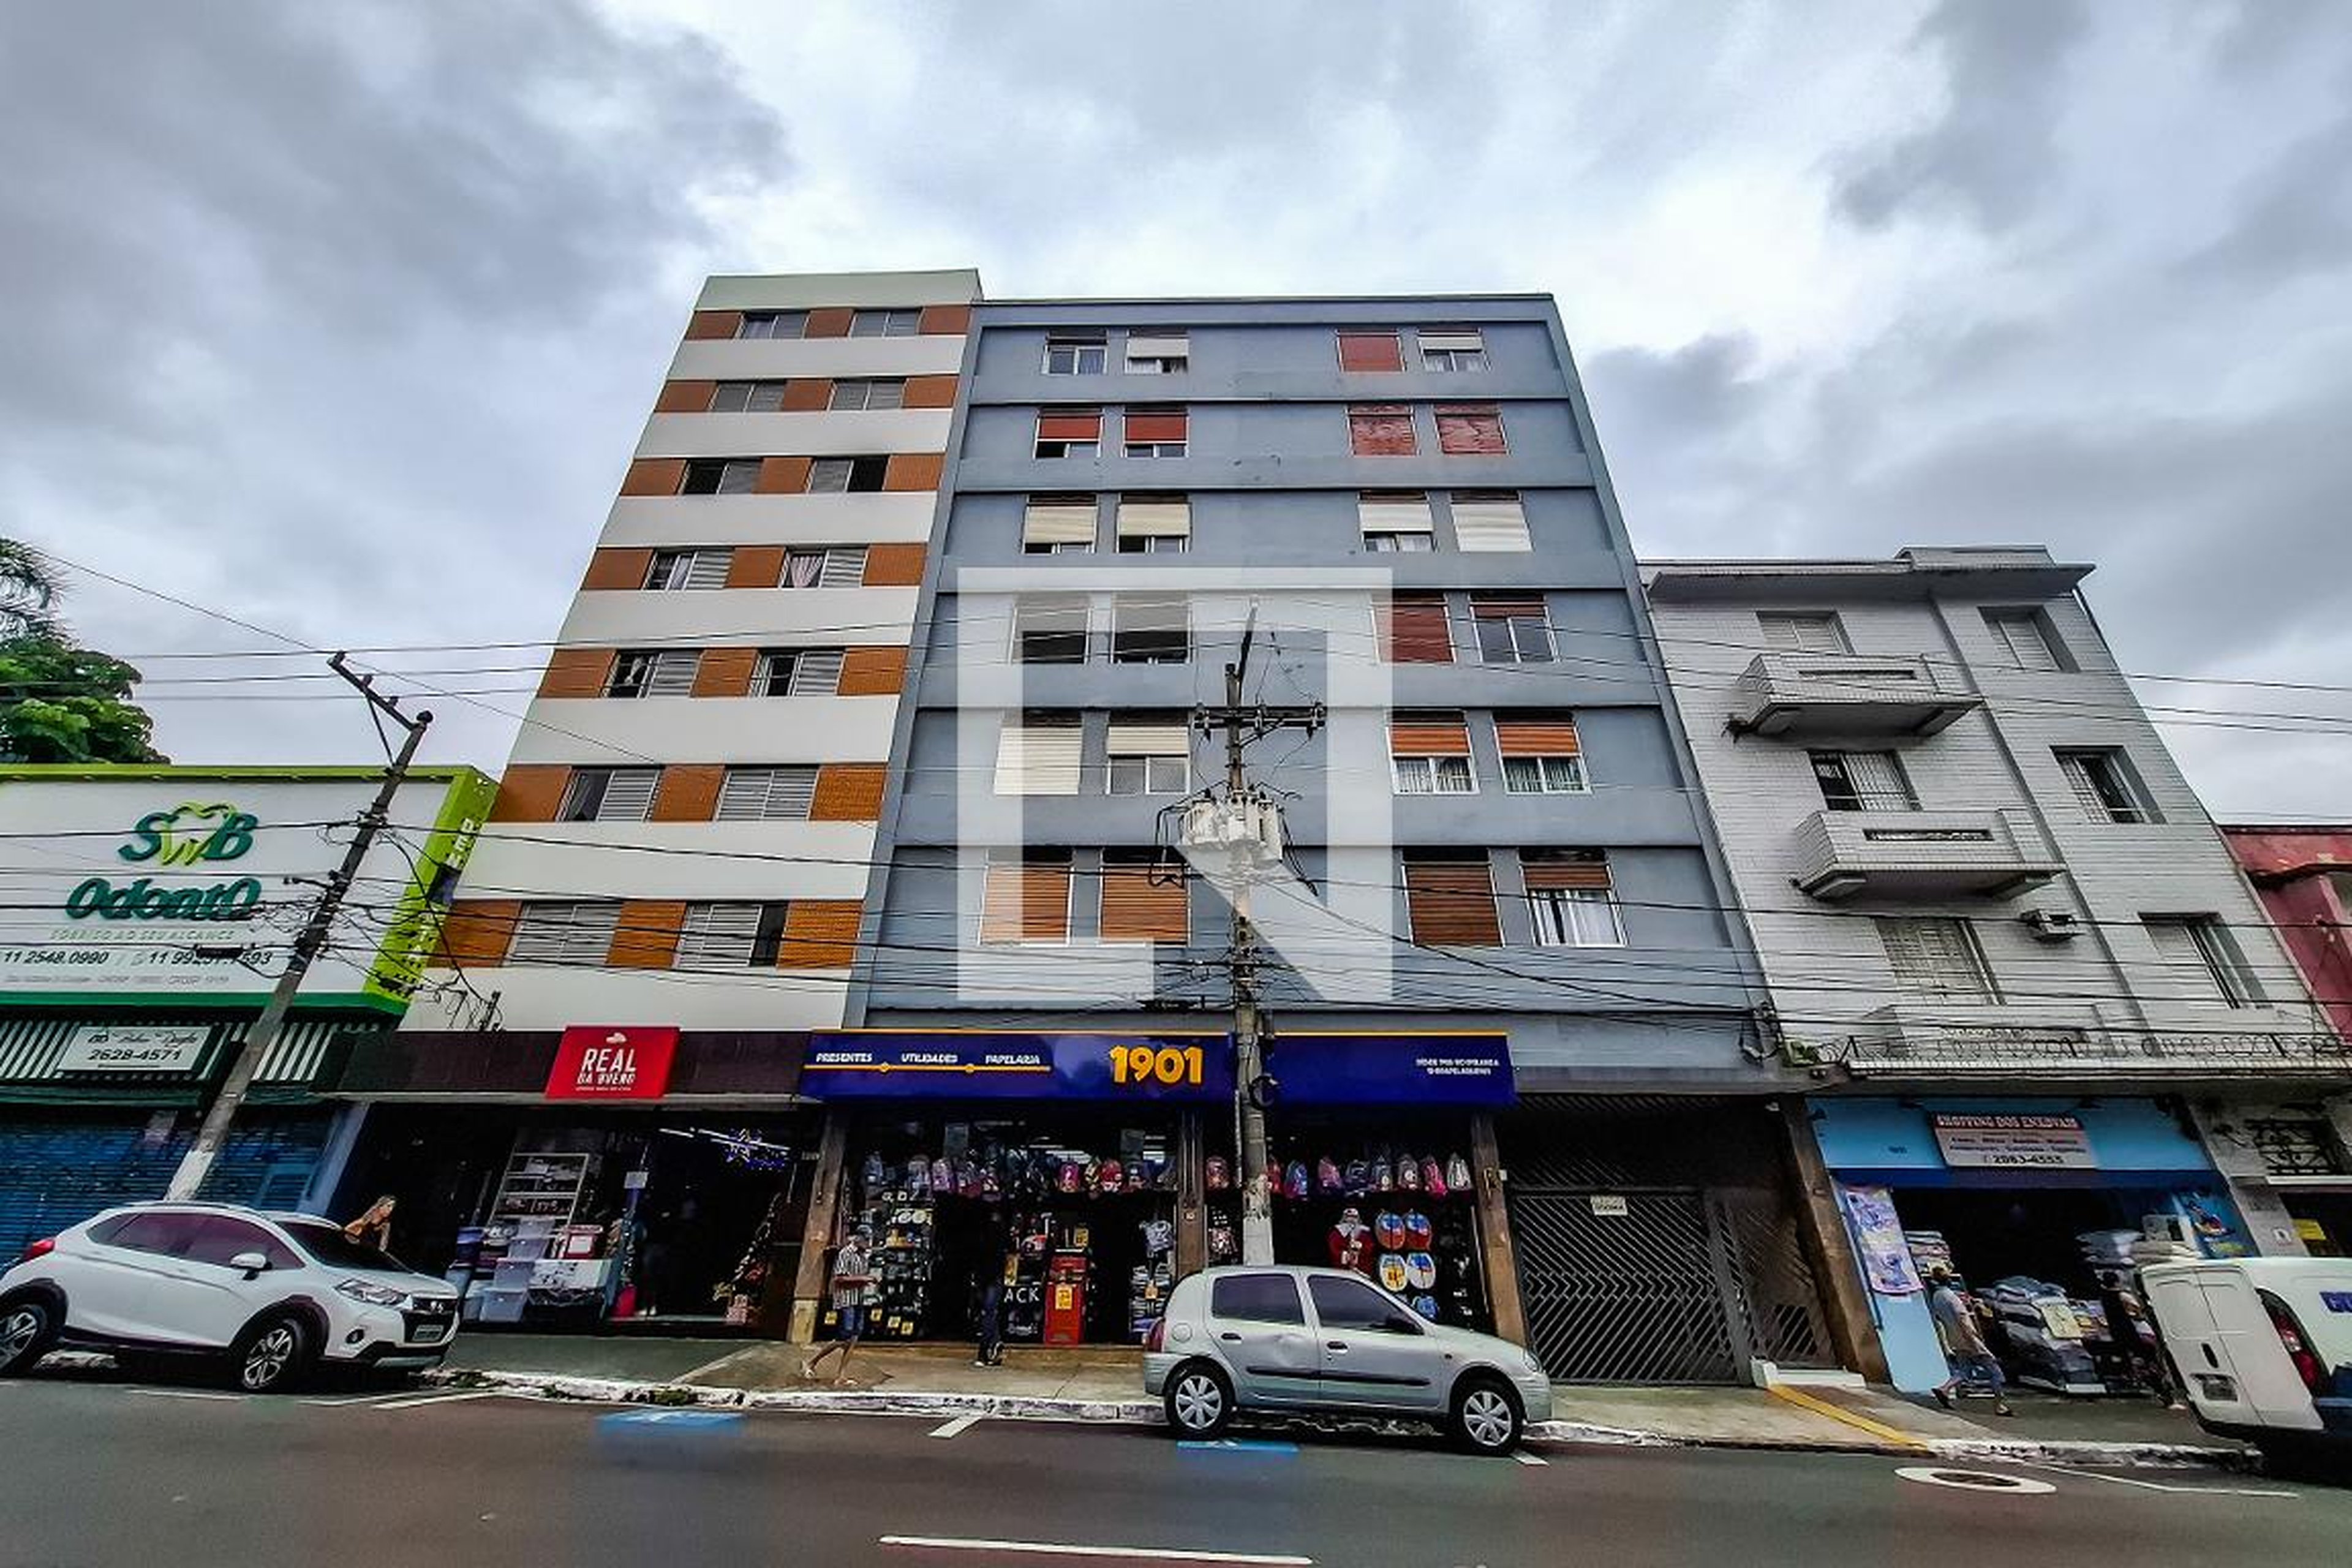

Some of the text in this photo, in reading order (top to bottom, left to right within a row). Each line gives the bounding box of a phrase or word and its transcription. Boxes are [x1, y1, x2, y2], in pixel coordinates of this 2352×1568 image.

[4, 951, 109, 965] 11 2548.0990
[149, 951, 168, 963] 11
[88, 1049, 182, 1060] 2628-4571
[581, 1048, 637, 1072] REAL
[816, 1053, 1041, 1065] PRESENTES UTILIDADES PAPELARIA
[1110, 1046, 1203, 1083] 1901
